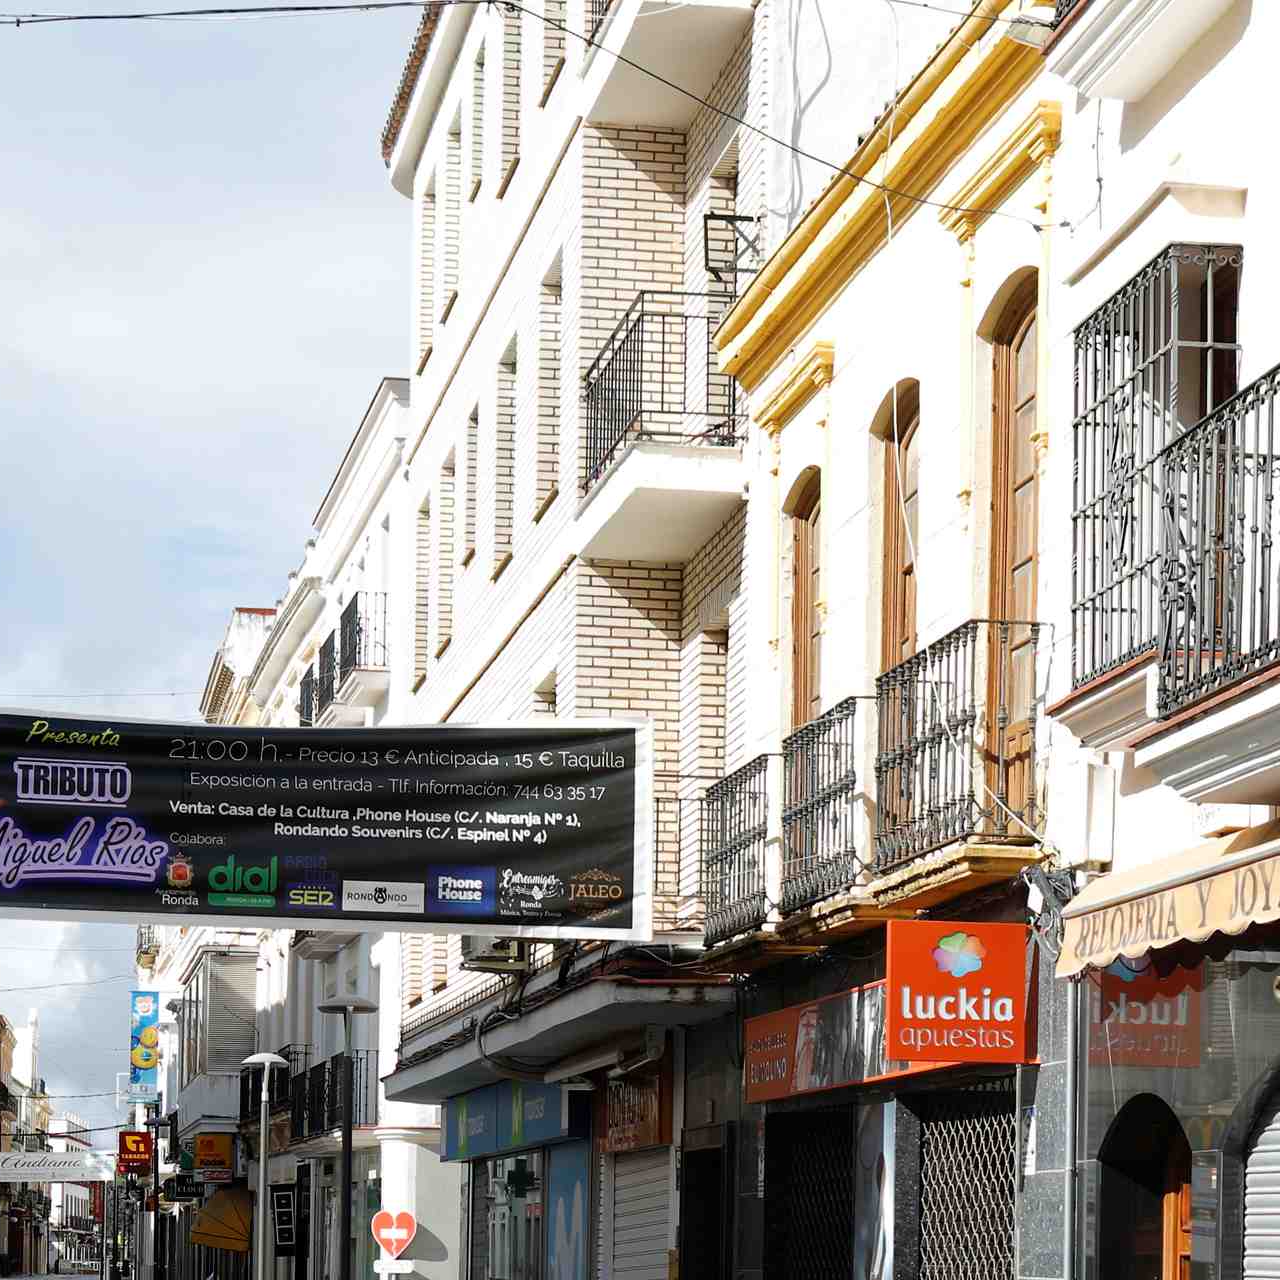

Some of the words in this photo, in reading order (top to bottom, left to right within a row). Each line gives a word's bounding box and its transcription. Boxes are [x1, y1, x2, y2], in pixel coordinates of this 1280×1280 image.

[25, 720, 121, 747] Presenta
[168, 738, 248, 761] 21:00
[299, 747, 355, 763] Precio
[360, 751, 379, 766] 13
[384, 749, 400, 765] €
[404, 749, 499, 768] Anticipada
[514, 753, 533, 769] 15
[538, 751, 553, 767] €
[558, 748, 625, 771] Taquilla
[16, 762, 130, 801] TRIBUTO
[189, 771, 276, 789] Exposición
[280, 778, 290, 790] a
[294, 776, 308, 790] la
[312, 777, 373, 793] entrada
[513, 784, 540, 800] 744
[543, 783, 563, 801] 63
[567, 786, 586, 801] 35
[590, 786, 607, 801] 17
[169, 800, 215, 815] Venta:
[219, 803, 254, 816] Casa
[257, 804, 276, 818] de
[280, 805, 294, 818] la
[296, 806, 349, 820] Cultura
[405, 809, 451, 823] House
[485, 811, 542, 828] Naranja
[544, 812, 563, 826] Nº
[93, 819, 166, 868] Ríos
[274, 822, 348, 837] Rondando
[351, 825, 423, 840] Souvenirs
[457, 826, 510, 844] Espinel
[512, 828, 531, 842] Nº
[533, 829, 548, 845] 4)
[207, 854, 278, 893] dial
[437, 875, 483, 890] Phone
[162, 894, 200, 907] Ronda
[288, 889, 334, 906] SER
[347, 887, 408, 905] RONDANDO
[437, 888, 482, 900] House
[520, 901, 542, 909] Ronda
[568, 883, 624, 903] JALEO
[1074, 890, 1180, 959] RELOJERIA
[1195, 878, 1215, 928] Y
[901, 986, 1015, 1022] luckia
[899, 1026, 1015, 1051] apuestas
